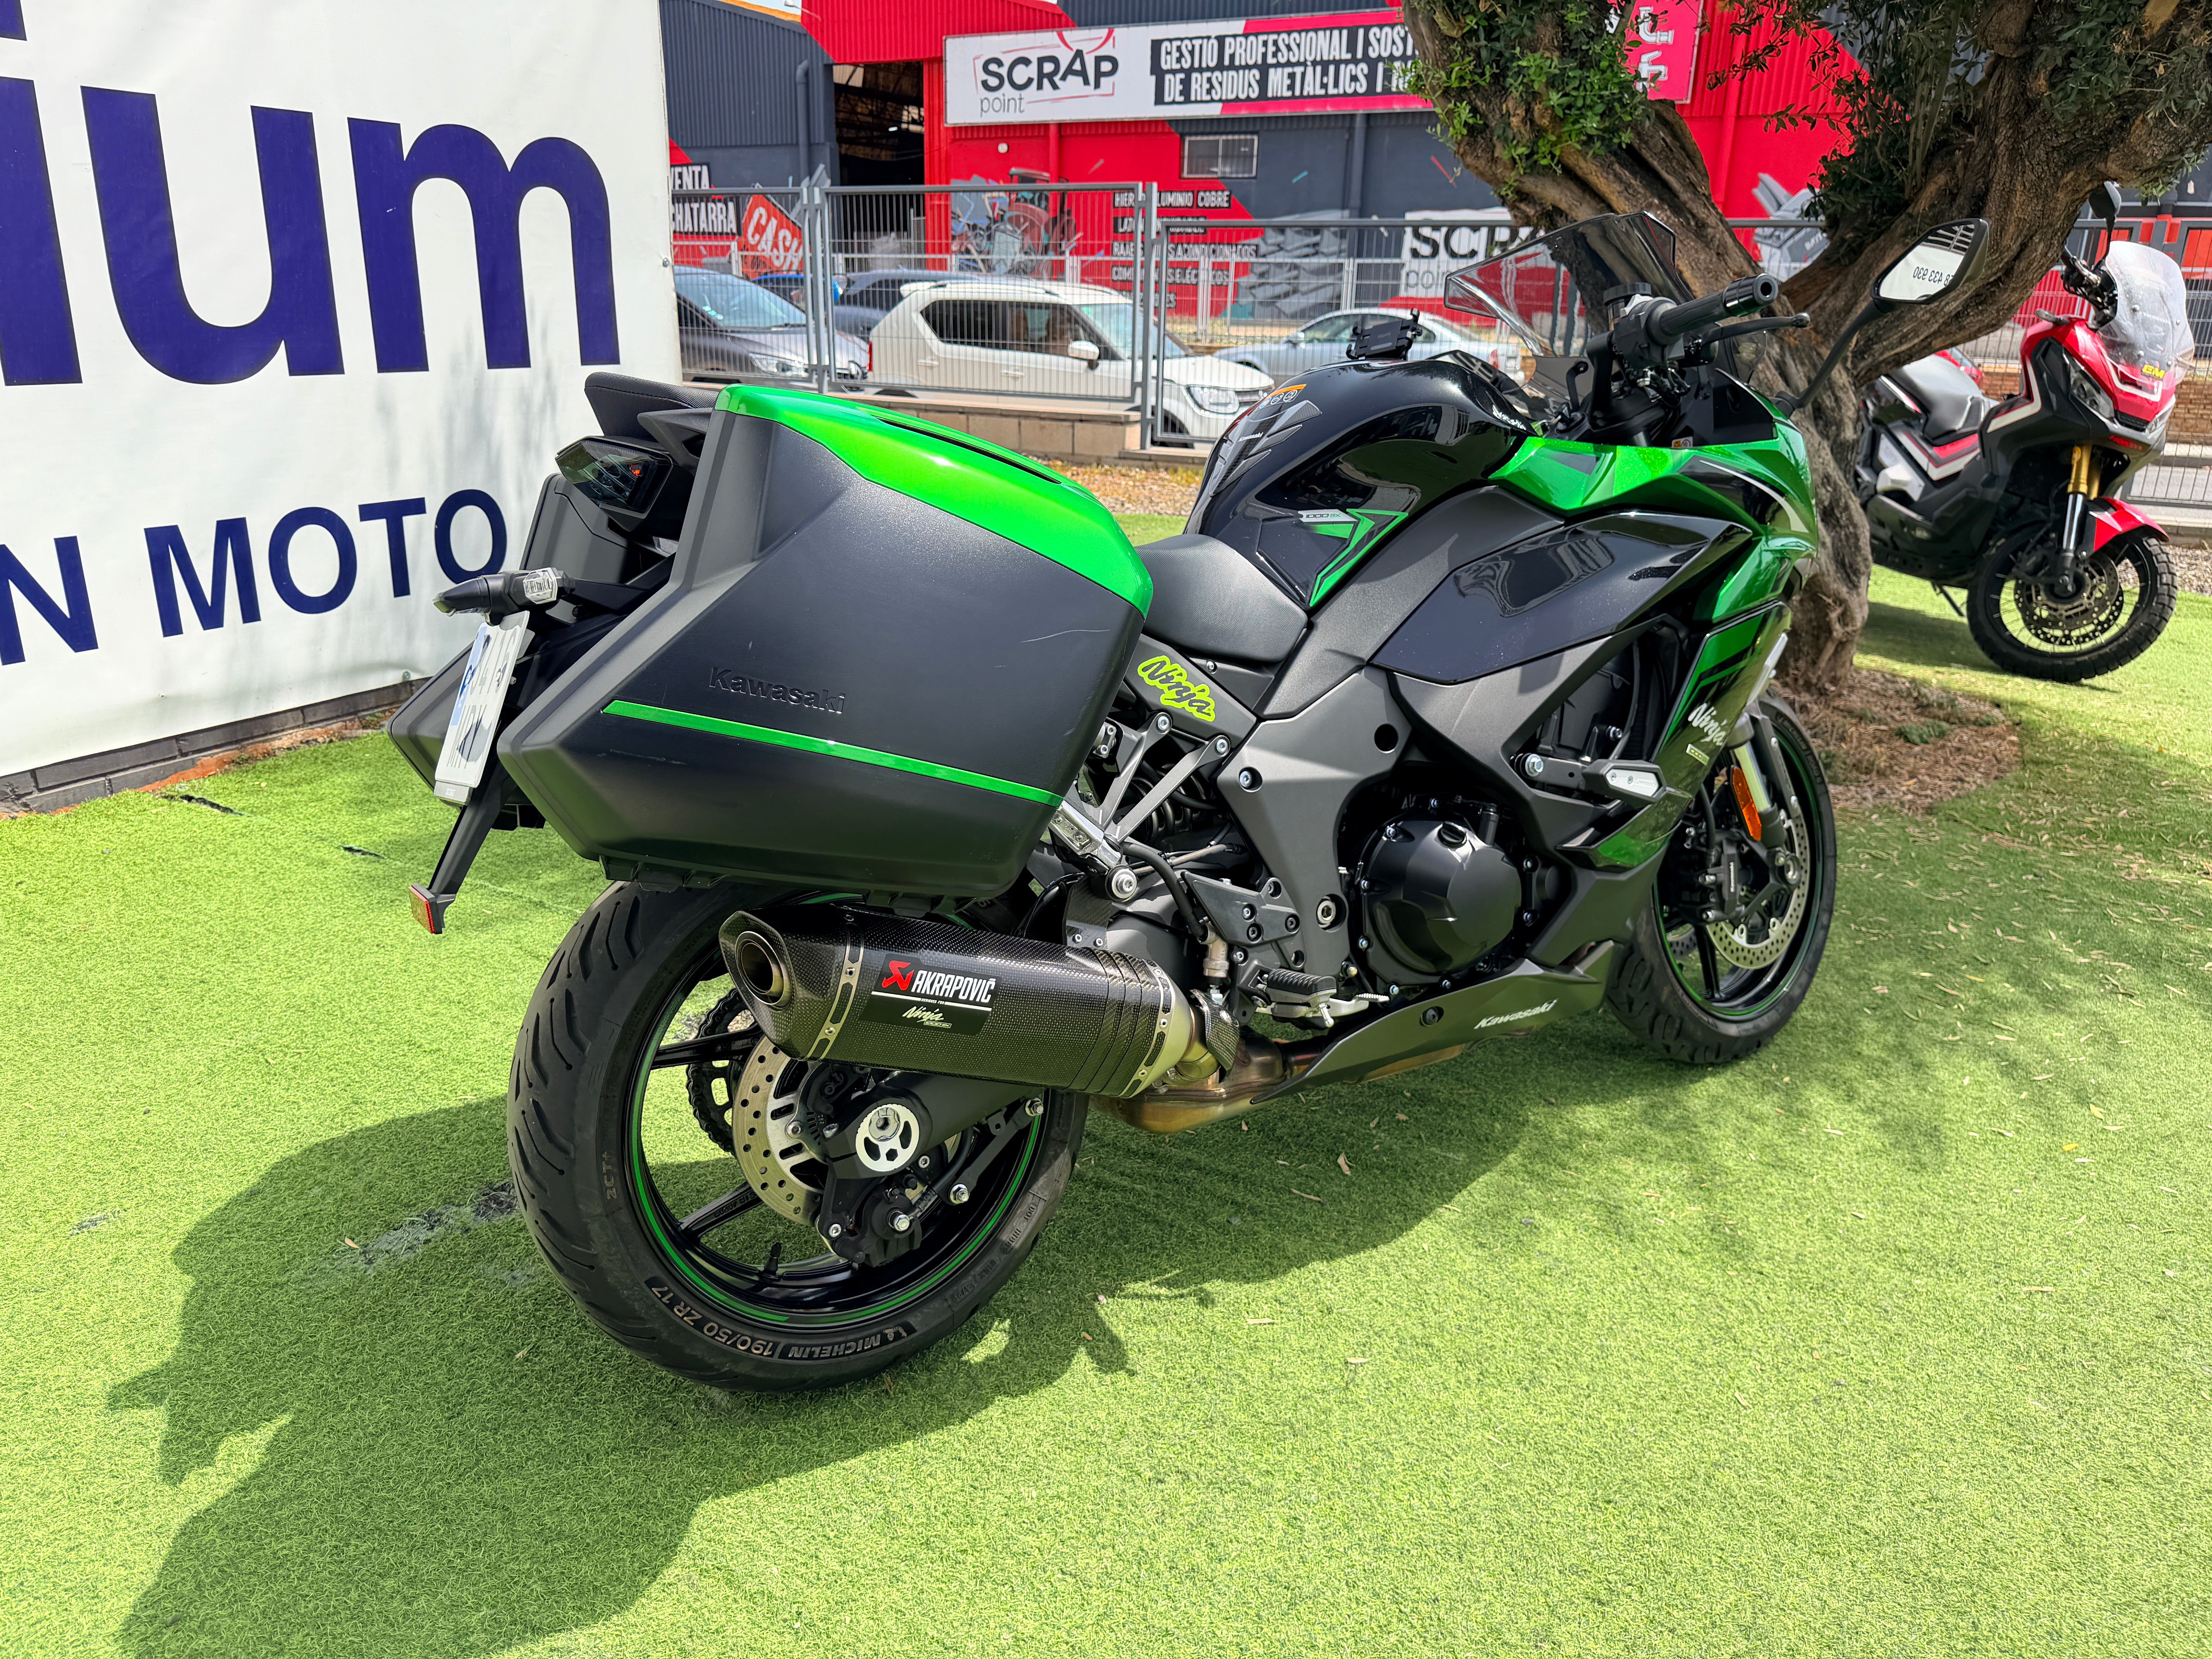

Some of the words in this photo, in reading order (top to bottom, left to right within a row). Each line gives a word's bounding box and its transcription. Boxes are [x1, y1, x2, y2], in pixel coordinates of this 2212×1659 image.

[1160, 35, 1218, 70] GESTIÓ
[1223, 30, 1352, 66] PROFESSIONAL
[1356, 27, 1364, 59] I
[1368, 24, 1419, 58] SOST
[981, 49, 1119, 92] SCRAP
[1164, 73, 1185, 103] DE
[1190, 69, 1260, 101] RESIDUS
[1267, 61, 1369, 97] METÀL·LICS
[1376, 61, 1384, 93] I
[980, 93, 1025, 117] point
[0, 0, 620, 386] ium
[1115, 192, 1146, 208] HIER
[1156, 191, 1194, 208] LUMINIO
[1197, 191, 1230, 208] COBRE
[747, 206, 803, 271] CASH
[1176, 244, 1257, 259] ACONDICIONDOS
[1411, 219, 1538, 258] SCR
[1176, 264, 1230, 286] ELÉCCOS
[0, 536, 99, 666] N
[144, 489, 507, 637] MOTO
[709, 666, 845, 714] Kawasaki
[1137, 655, 1216, 722] Ninja
[1688, 702, 1727, 747] Ninja
[902, 1006, 944, 1022] Ninja
[1474, 998, 1559, 1029] Kawasaki
[652, 1285, 669, 1305] 17
[673, 1301, 702, 1326] ZR
[704, 1321, 773, 1356] 190/50
[789, 1335, 881, 1358] MICHELIN
